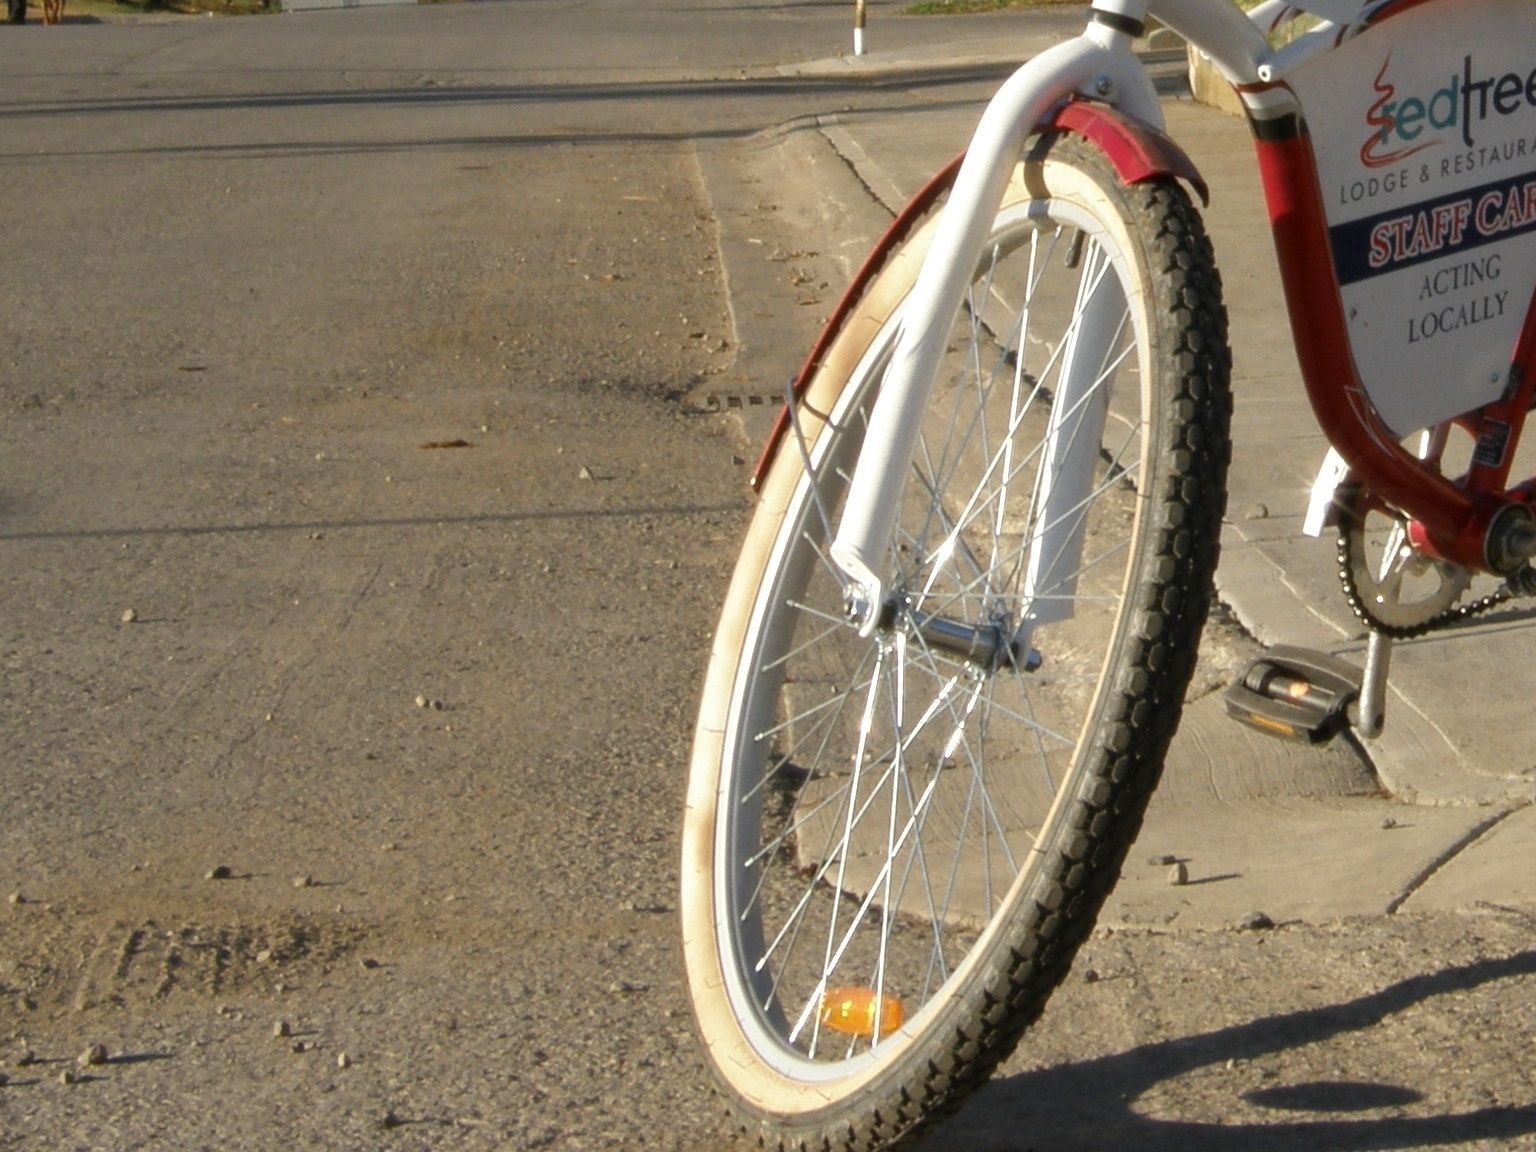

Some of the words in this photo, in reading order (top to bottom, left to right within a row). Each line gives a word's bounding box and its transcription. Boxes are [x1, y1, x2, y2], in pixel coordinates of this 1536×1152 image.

[1340, 168, 1410, 204] LODGE
[1418, 163, 1431, 184] &
[1368, 198, 1473, 268] STAFF
[1419, 254, 1501, 300] ACTING
[1408, 290, 1509, 344] LOCALLY
